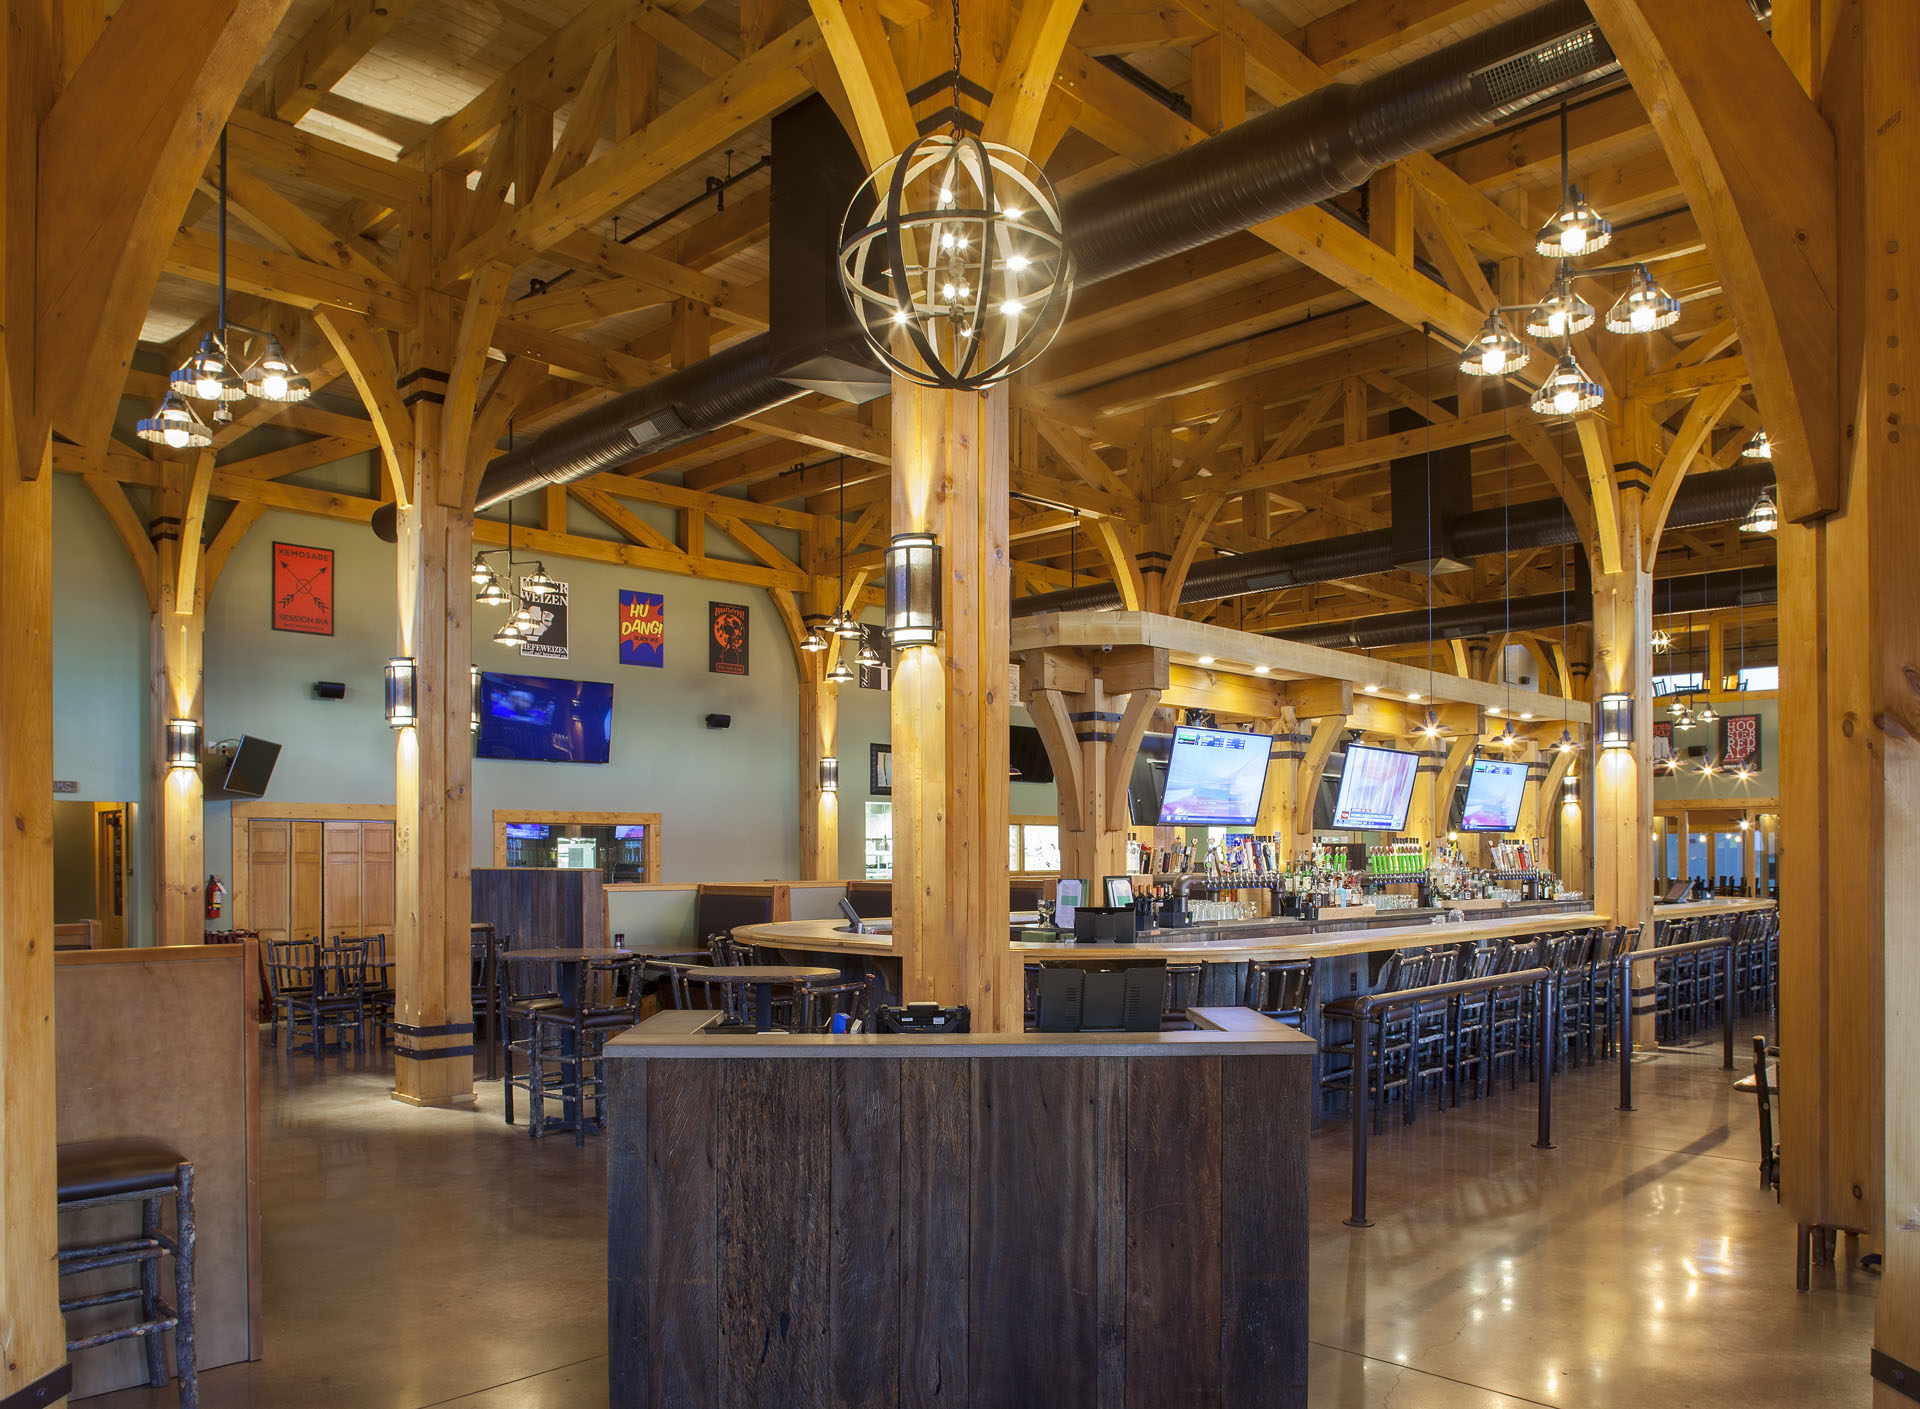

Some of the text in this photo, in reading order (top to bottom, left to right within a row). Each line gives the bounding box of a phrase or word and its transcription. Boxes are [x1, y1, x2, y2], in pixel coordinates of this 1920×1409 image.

[278, 548, 329, 562] KEMOSABE
[630, 603, 649, 618] HU
[278, 613, 329, 625] SESSION IPA
[621, 618, 664, 638] DANG!
[1727, 720, 1756, 732] HOO
[1727, 731, 1756, 741] SIER
[1727, 739, 1756, 750] RED
